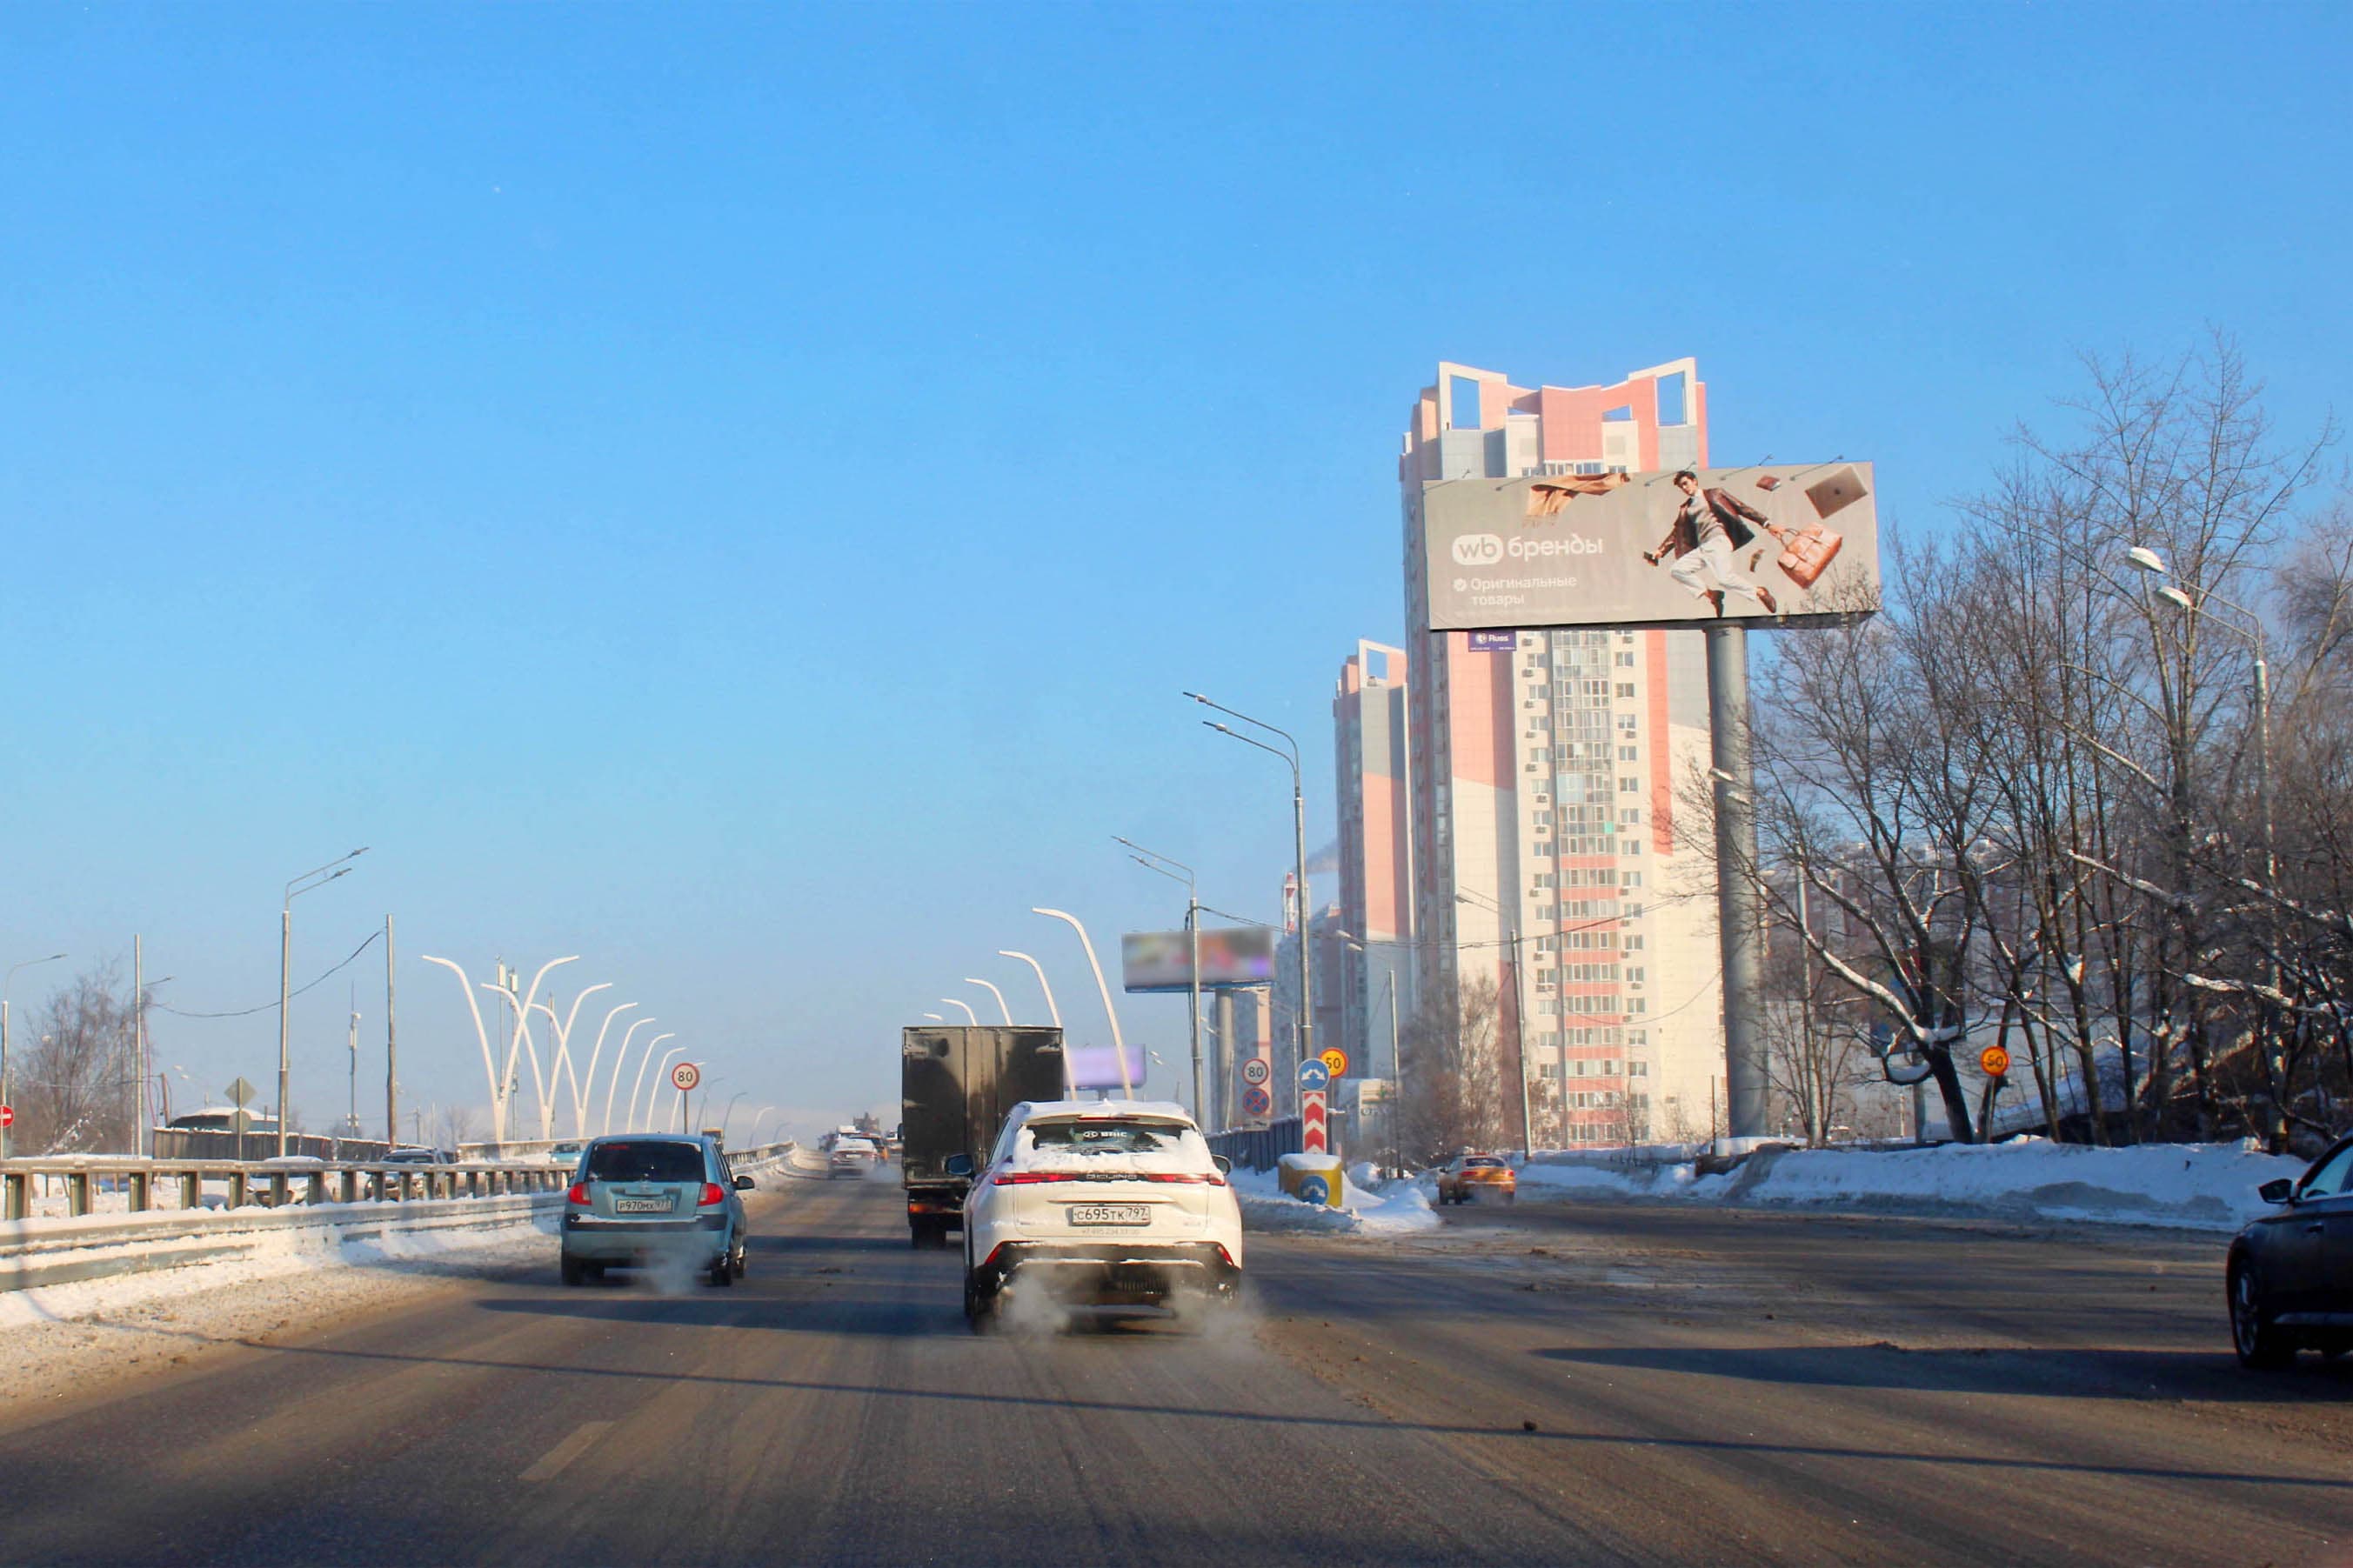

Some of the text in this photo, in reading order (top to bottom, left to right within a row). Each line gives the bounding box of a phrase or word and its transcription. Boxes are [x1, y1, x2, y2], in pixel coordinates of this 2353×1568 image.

[1459, 533, 1603, 562] wb бренды
[1470, 577, 1577, 592] Оригинальные
[1471, 594, 1525, 608] товары
[1326, 1057, 1341, 1070] 50
[1988, 1055, 2003, 1066] 50
[678, 1071, 693, 1082] 80
[1247, 1066, 1264, 1078] 80
[1127, 1207, 1146, 1217] 797
